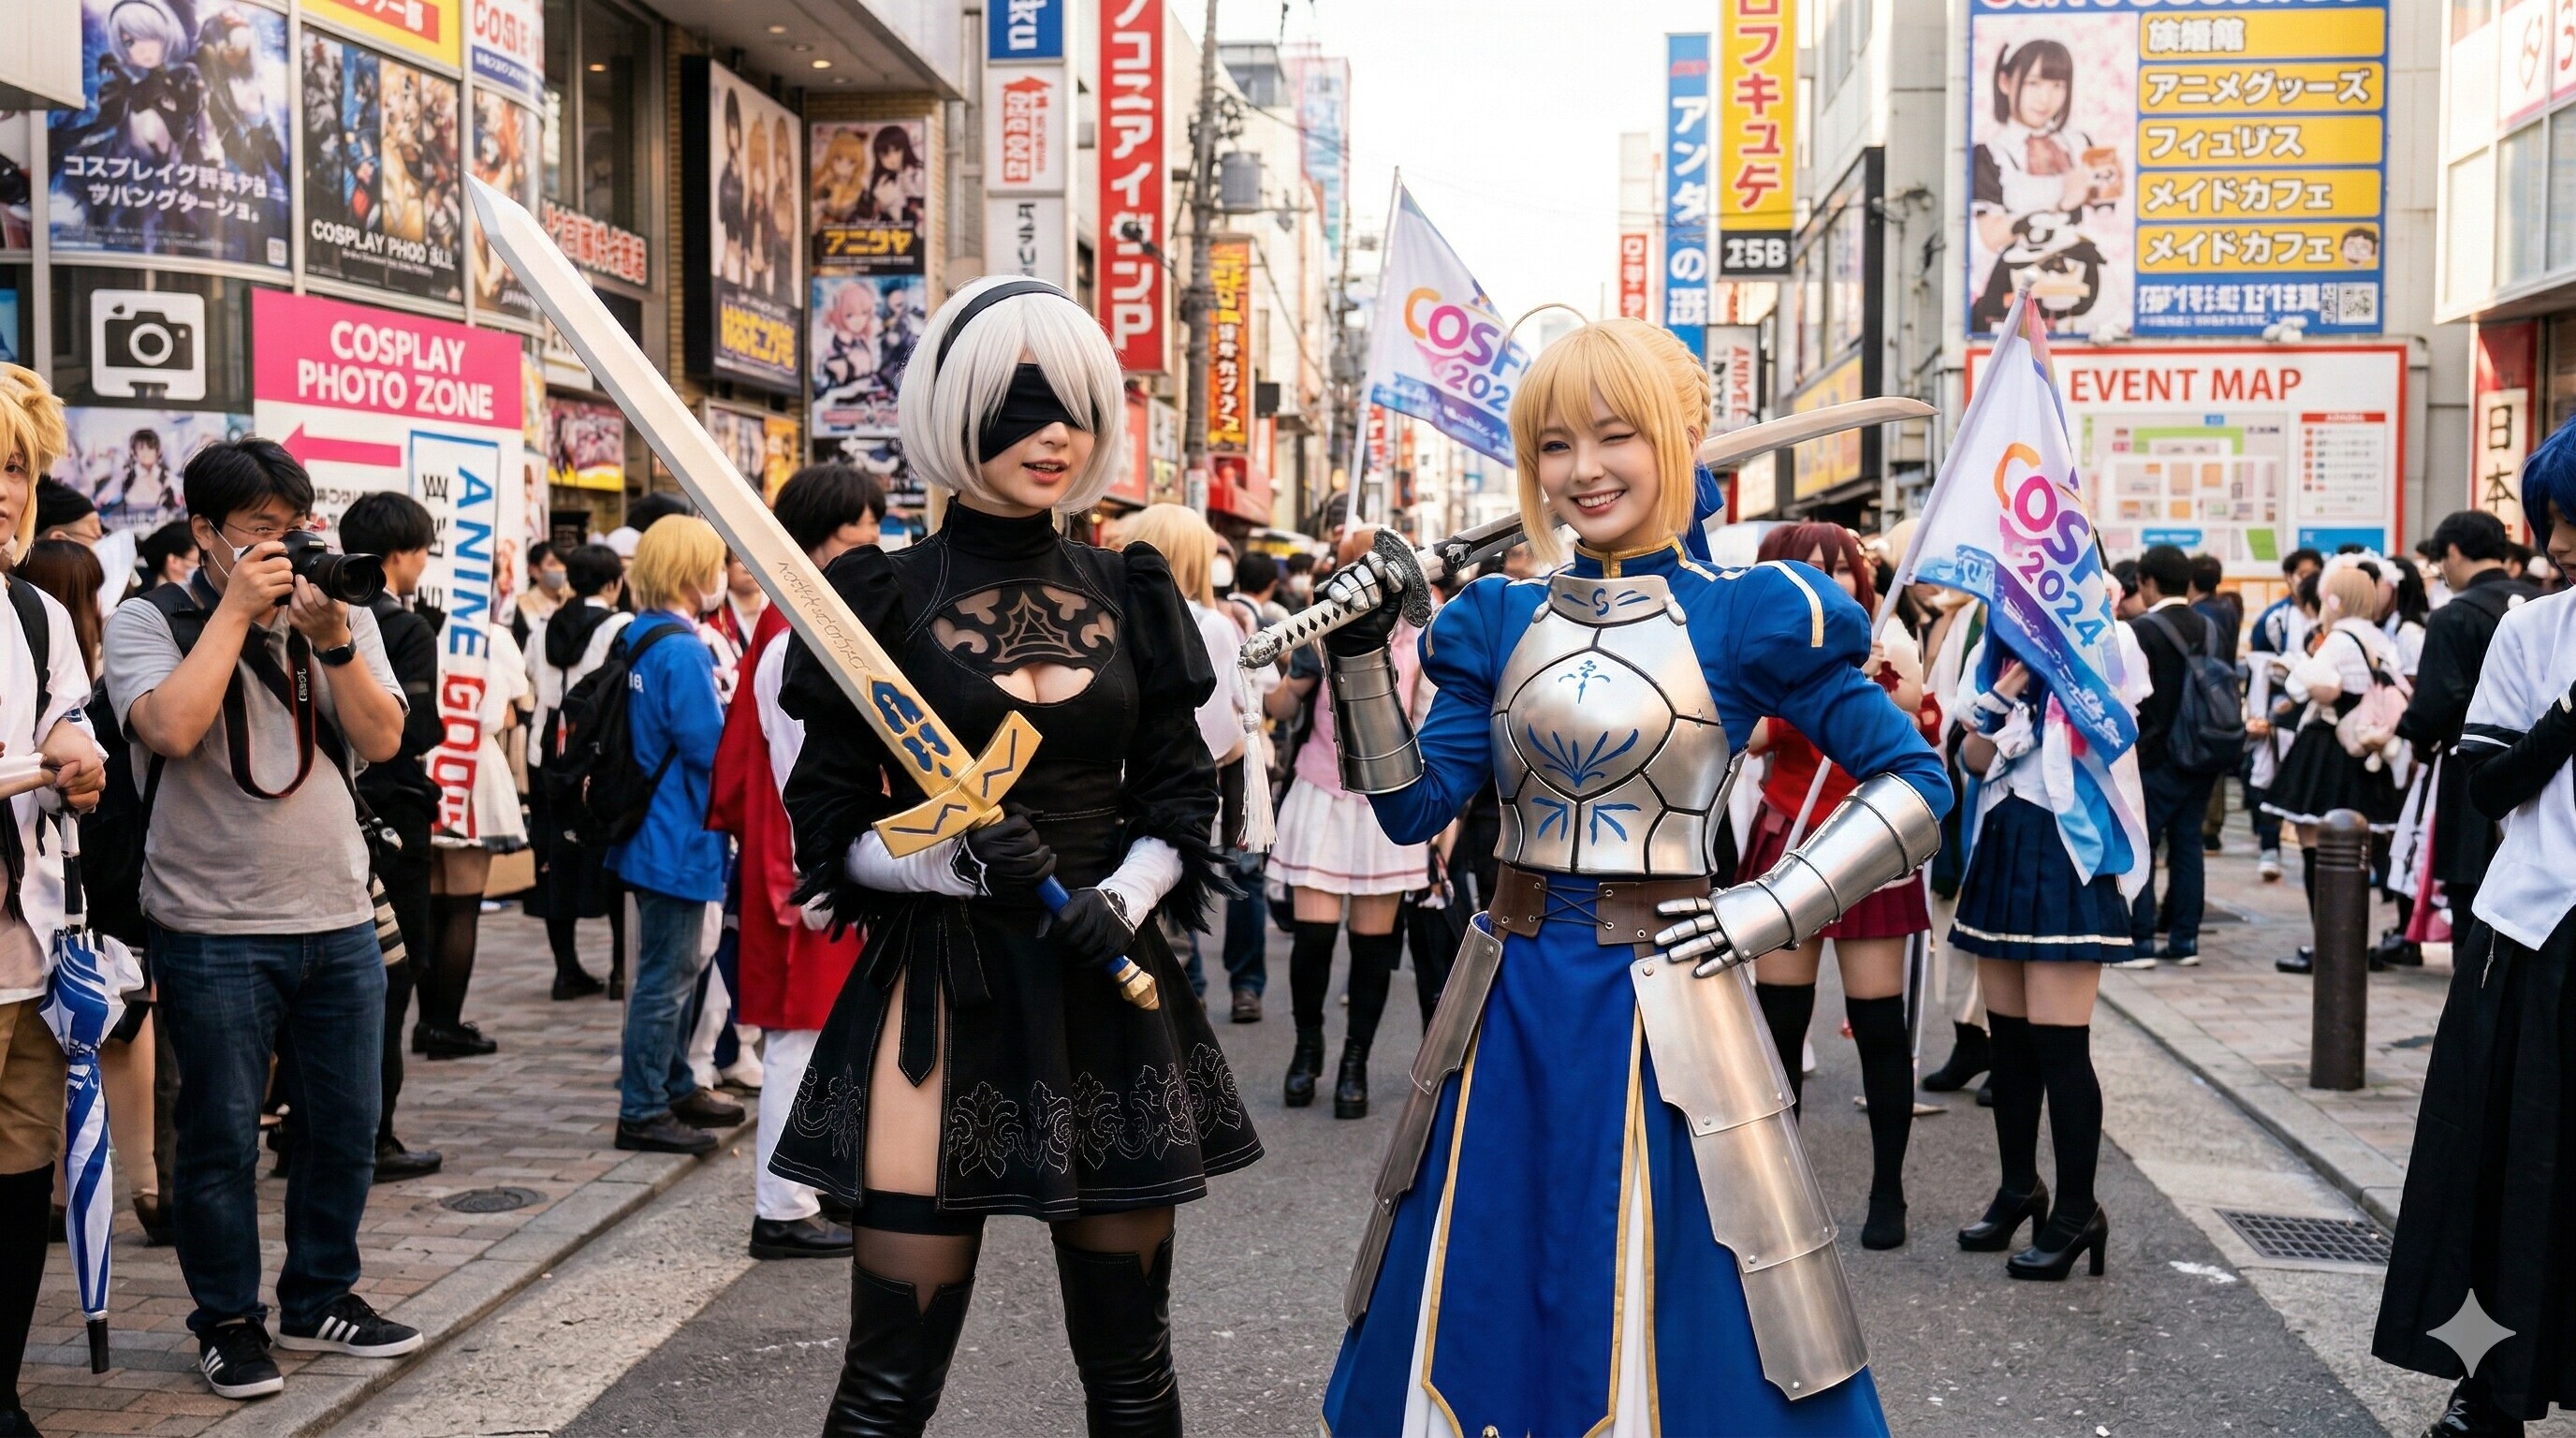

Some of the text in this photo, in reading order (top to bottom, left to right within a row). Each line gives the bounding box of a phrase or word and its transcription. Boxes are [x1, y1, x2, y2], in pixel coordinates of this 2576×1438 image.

[2145, 178, 2333, 212] メイドカフェ
[311, 218, 385, 256] COSPLAY
[2144, 231, 2334, 265] メイドカフェ
[329, 320, 466, 374] COSPLAY
[298, 358, 494, 420] PHOTO ZONE
[2070, 368, 2303, 402] EVENT MAP
[2485, 404, 2517, 512] 日本
[2018, 550, 2106, 648] 2024
